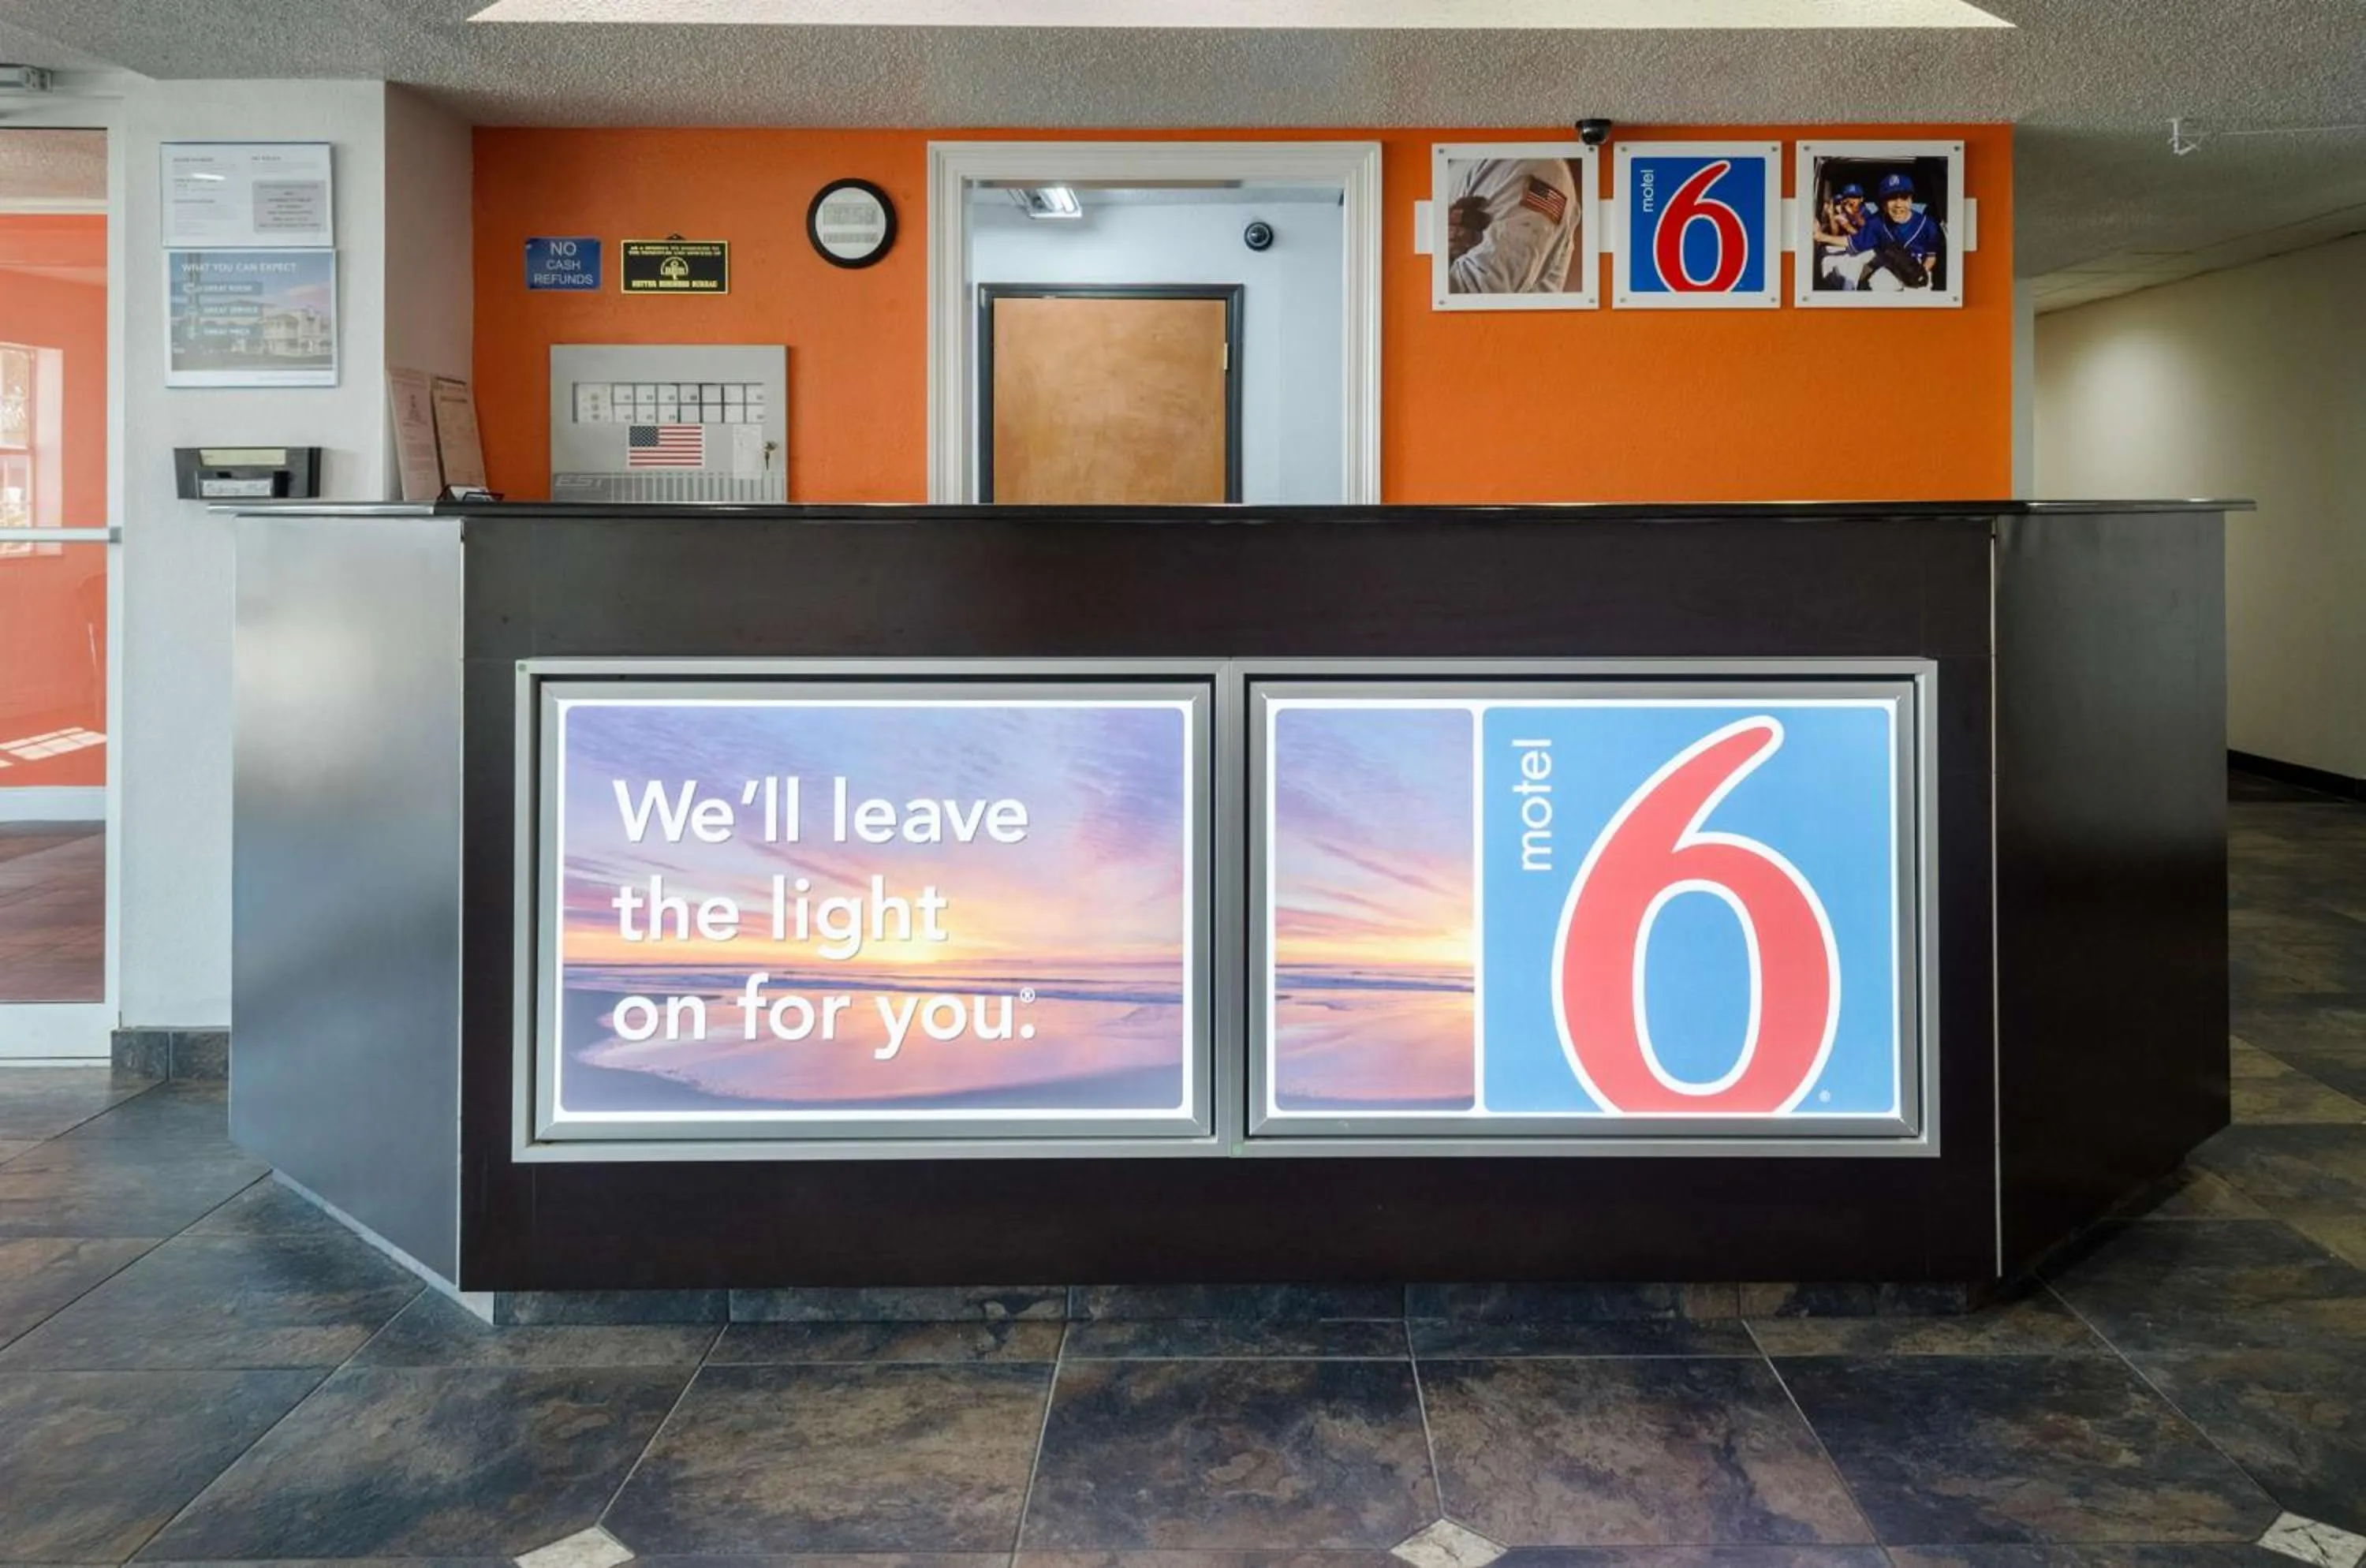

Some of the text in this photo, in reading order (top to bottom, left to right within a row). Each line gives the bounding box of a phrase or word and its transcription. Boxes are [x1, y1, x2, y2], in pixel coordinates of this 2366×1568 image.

[1640, 169, 1655, 213] motel
[550, 240, 577, 257] NO
[1653, 160, 1748, 293] 6
[181, 263, 297, 273] WHAT YOU CAN EXPECT
[533, 273, 595, 286] REFUNDS
[546, 258, 581, 271] CASH
[612, 776, 1029, 844] We'll leave
[1511, 738, 1553, 872] motel
[612, 875, 949, 961] the light
[1551, 715, 1842, 1114] 6
[612, 994, 707, 1042] on
[742, 973, 852, 1042] for
